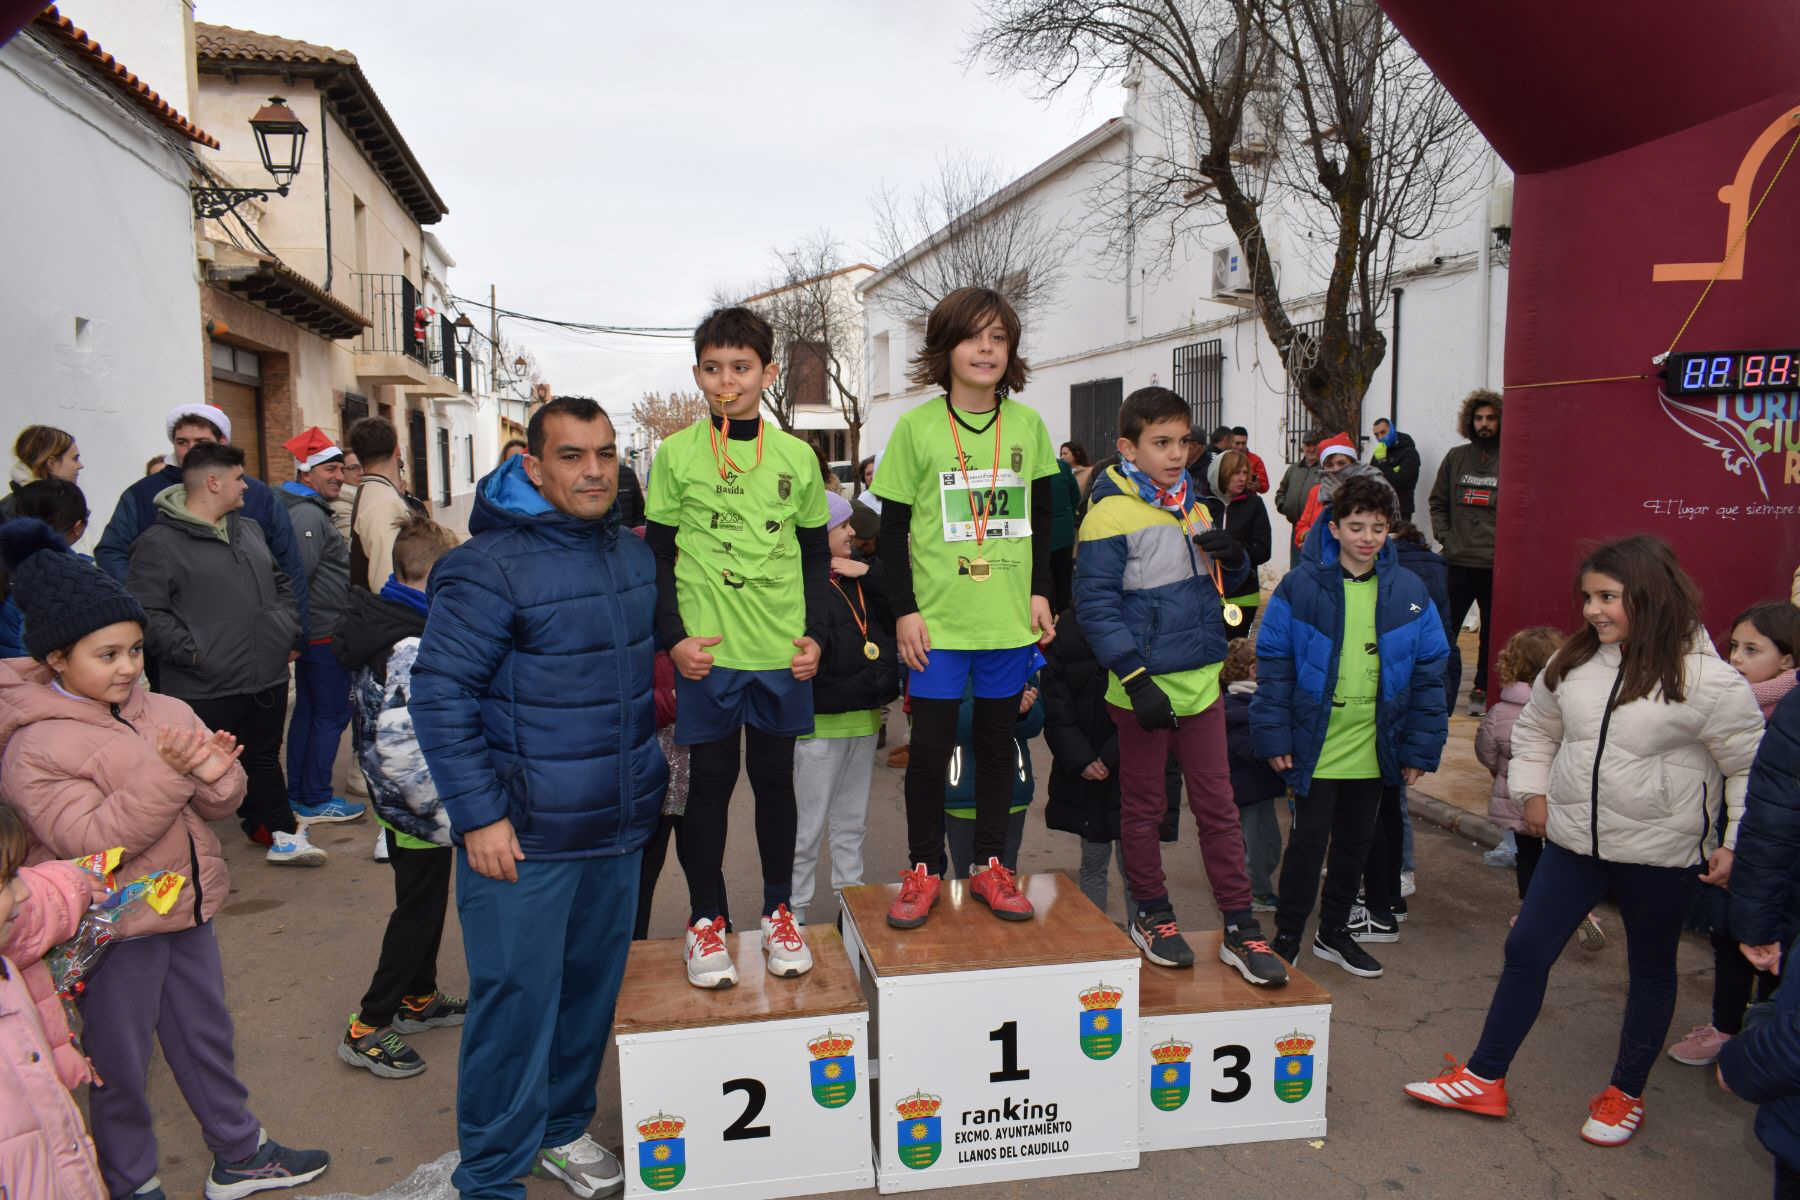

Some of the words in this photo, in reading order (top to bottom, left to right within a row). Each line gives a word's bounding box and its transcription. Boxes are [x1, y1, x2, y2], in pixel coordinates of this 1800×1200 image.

[1717, 392, 1800, 421] TURI
[1678, 499, 1709, 520] lugar
[1716, 504, 1740, 520] que
[1746, 502, 1794, 518] siempre
[989, 1020, 1030, 1083] 1
[1211, 1044, 1252, 1103] 3
[722, 1077, 771, 1141] 2
[962, 1096, 1058, 1126] ranking
[955, 1129, 992, 1144] EXCMO.
[995, 1121, 1072, 1140] AYUNTAMIENTO
[958, 1148, 997, 1163] LLANOS
[1000, 1145, 1018, 1159] DEL
[1020, 1140, 1069, 1157] CAUDILLO
